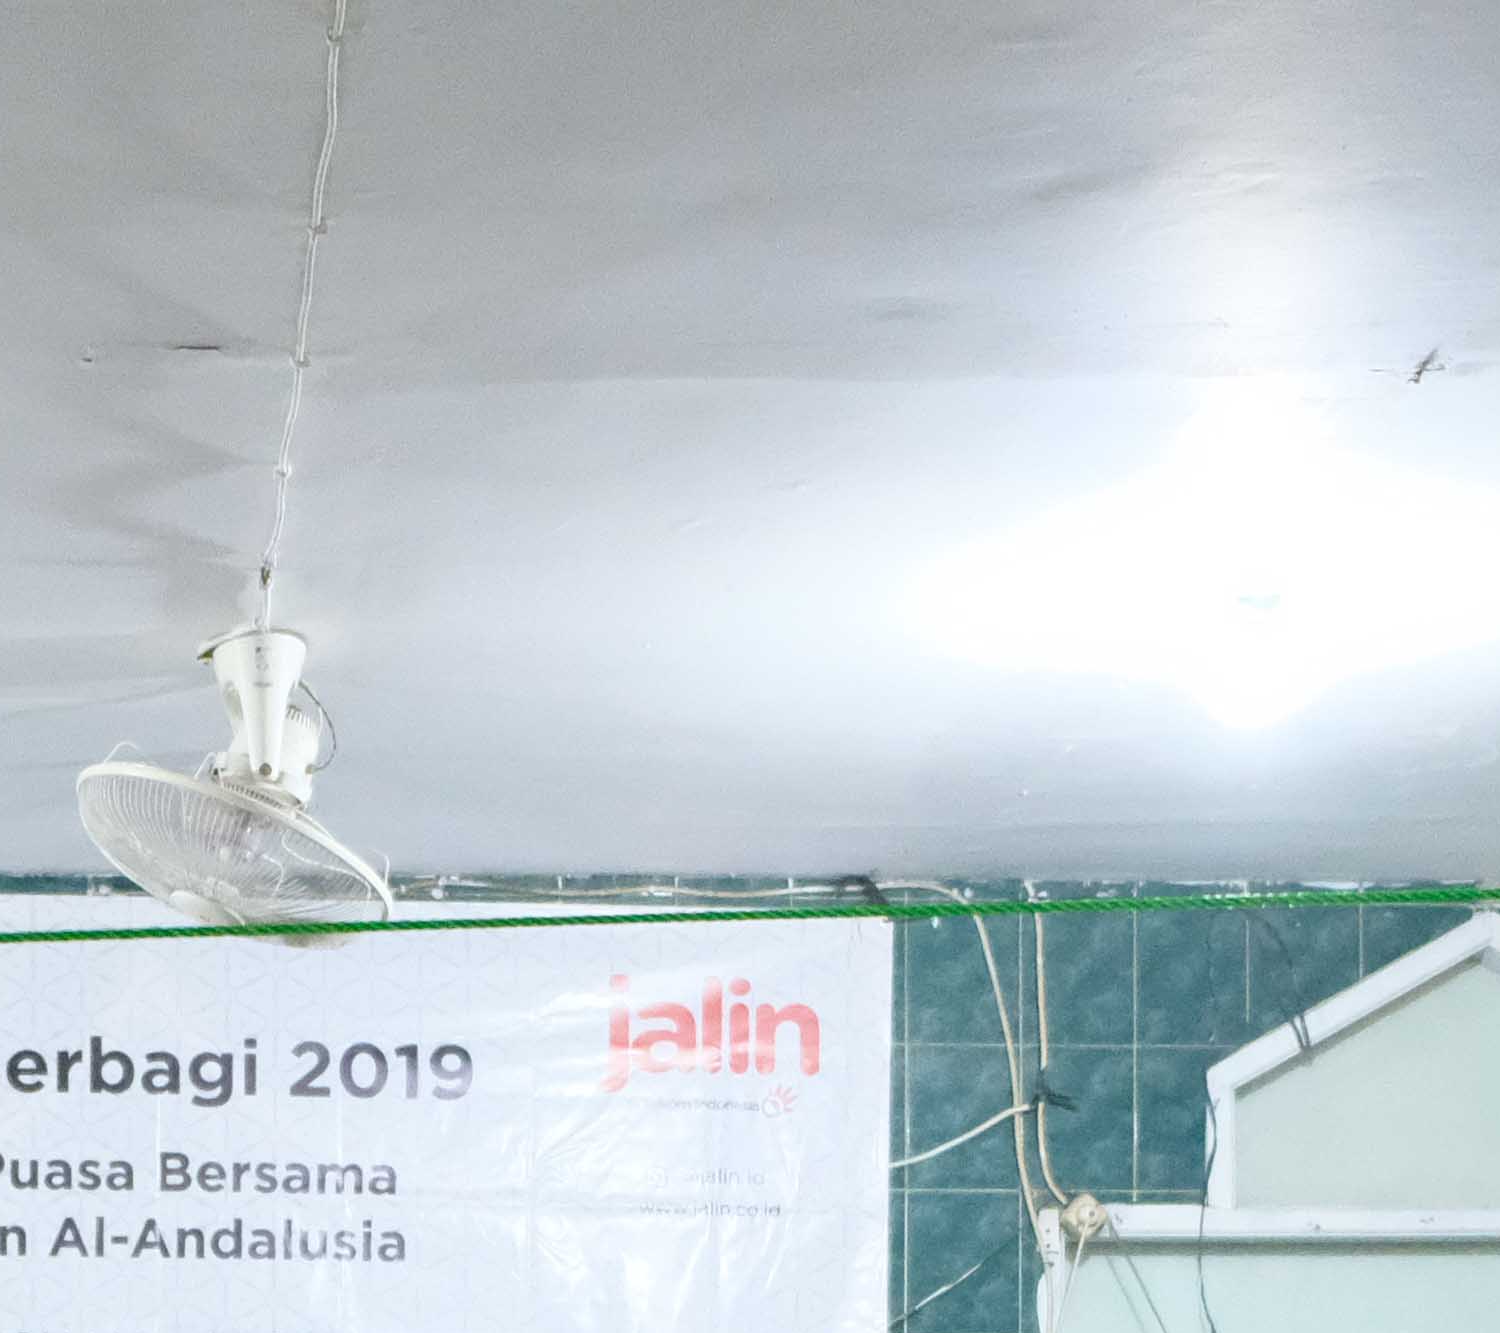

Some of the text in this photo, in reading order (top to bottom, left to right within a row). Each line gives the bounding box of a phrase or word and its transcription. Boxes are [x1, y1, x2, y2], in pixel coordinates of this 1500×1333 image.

[602, 973, 821, 1093] jalin
[289, 1040, 474, 1100] 2019
[159, 1151, 397, 1196] Bersama
[48, 1215, 406, 1262] Al-Andalusia
